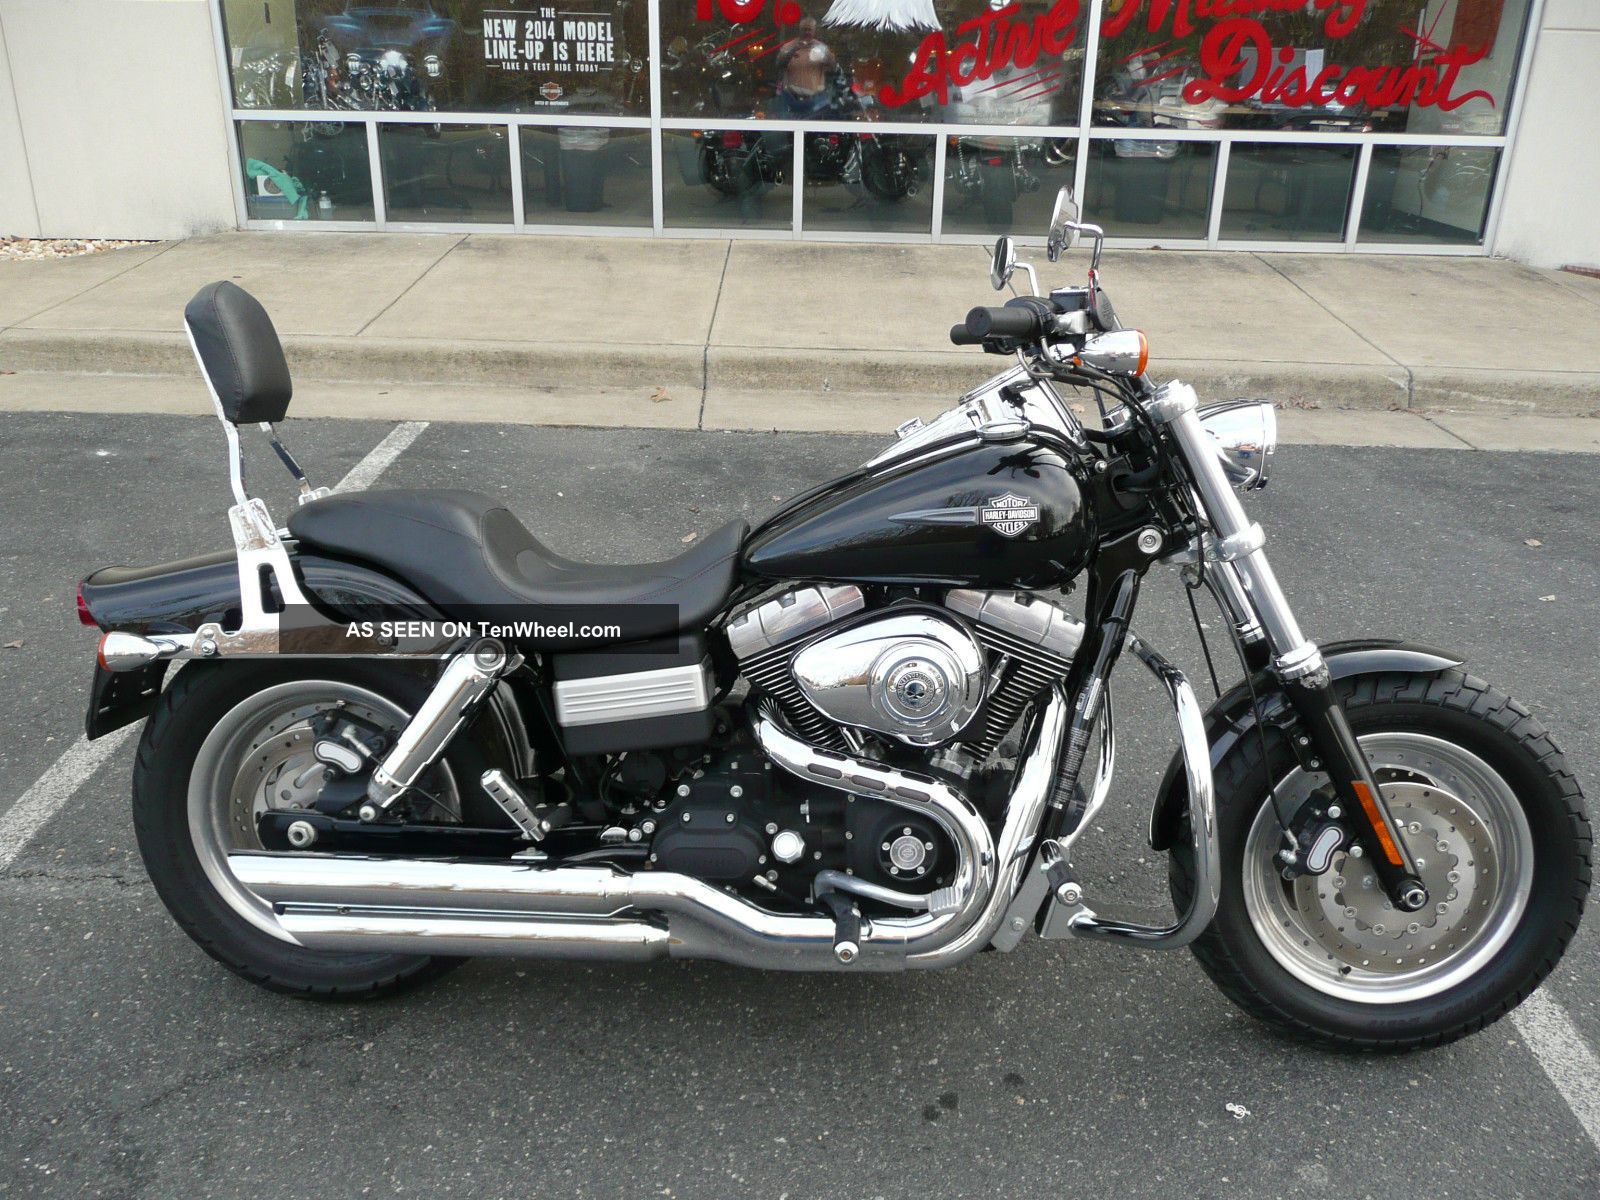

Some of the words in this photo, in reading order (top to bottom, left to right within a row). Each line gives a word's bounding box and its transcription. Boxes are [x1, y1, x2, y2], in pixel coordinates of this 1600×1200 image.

[540, 7, 556, 18] THE
[483, 18, 517, 39] NEW
[525, 20, 556, 40] 2014
[563, 21, 614, 42] MODEL
[484, 39, 545, 61] LINE-UP
[552, 41, 569, 61] IS
[576, 42, 615, 62] HERE
[879, 0, 1081, 108] Active
[502, 61, 521, 71] TAKE
[524, 62, 529, 71] A
[533, 62, 551, 71] TEST
[554, 63, 572, 72] RIDE
[575, 63, 599, 73] TODAY
[1183, 18, 1495, 111] Discount
[996, 497, 1024, 508] MOTOR
[985, 509, 1035, 520] HARLEY-DAVIDSON
[996, 521, 1024, 534] CYCLES
